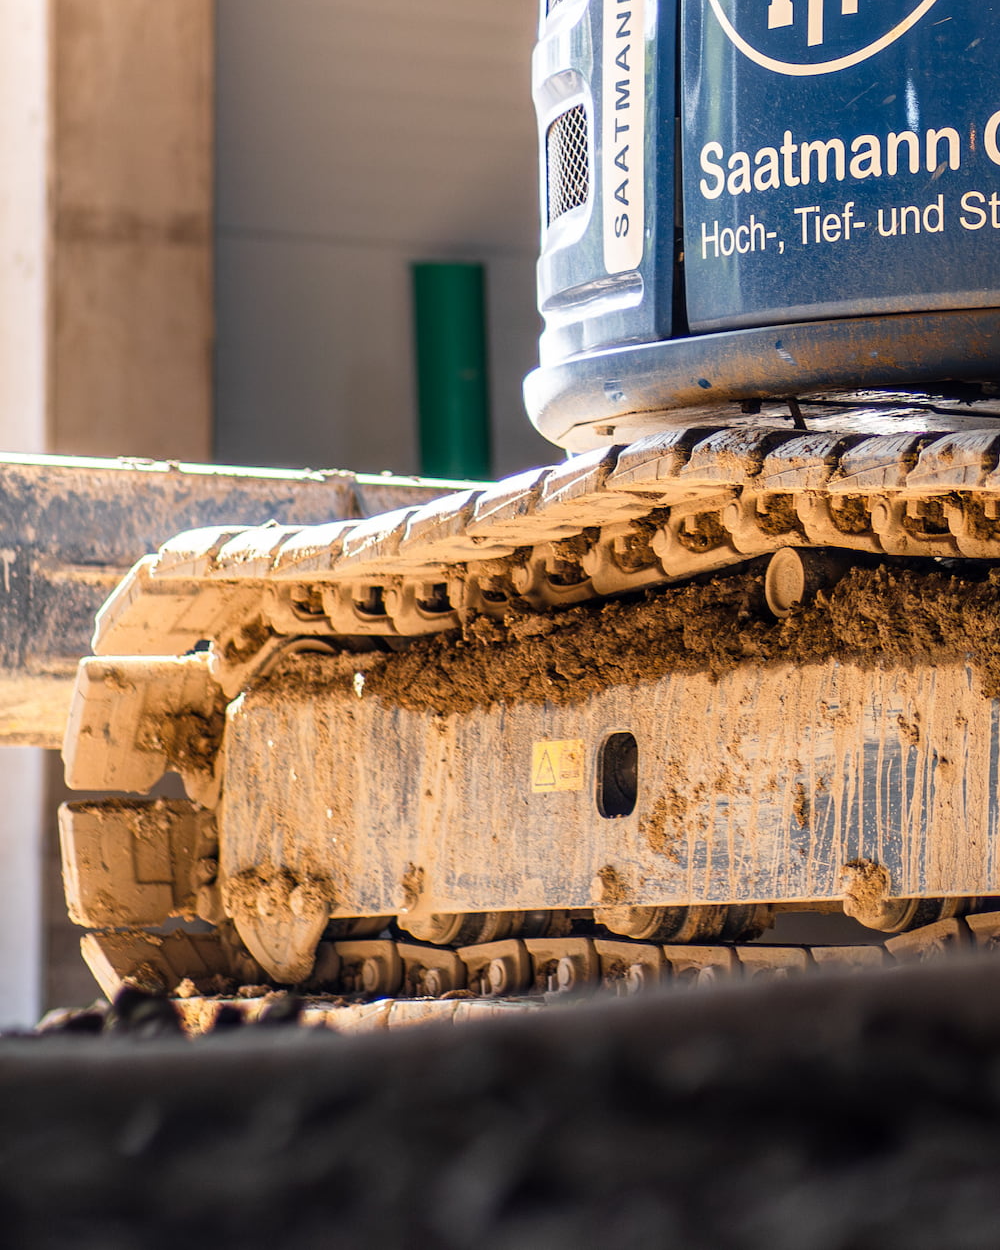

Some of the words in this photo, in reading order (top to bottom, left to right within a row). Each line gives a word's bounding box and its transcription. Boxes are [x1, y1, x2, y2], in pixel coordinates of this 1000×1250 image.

[699, 128, 960, 200] Saatmann
[700, 213, 786, 260] Hoch-,
[793, 200, 867, 246] Tief-
[877, 194, 945, 237] und
